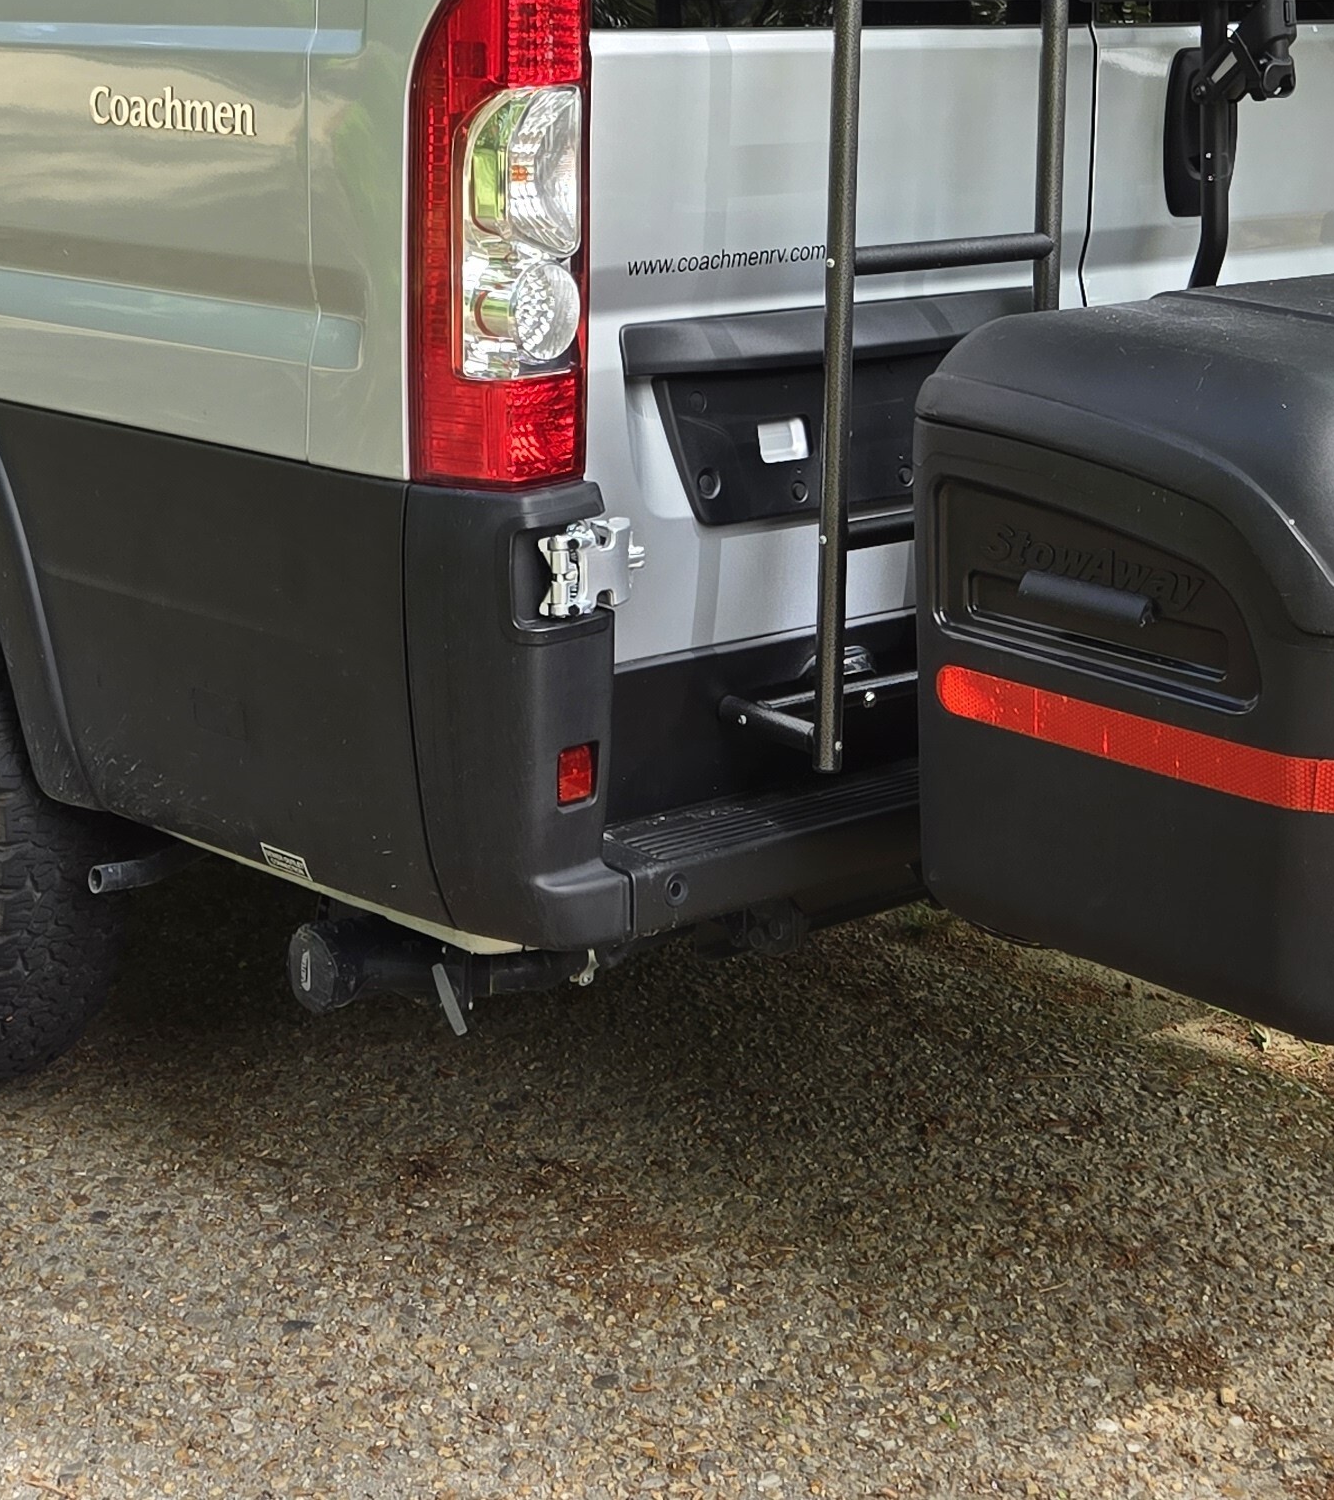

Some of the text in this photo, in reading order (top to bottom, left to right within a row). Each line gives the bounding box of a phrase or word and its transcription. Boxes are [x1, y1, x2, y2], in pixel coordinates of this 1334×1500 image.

[89, 85, 257, 136] Coachmen
[627, 243, 827, 277] www.coachmenrv.com
[984, 521, 1207, 613] StowAway
